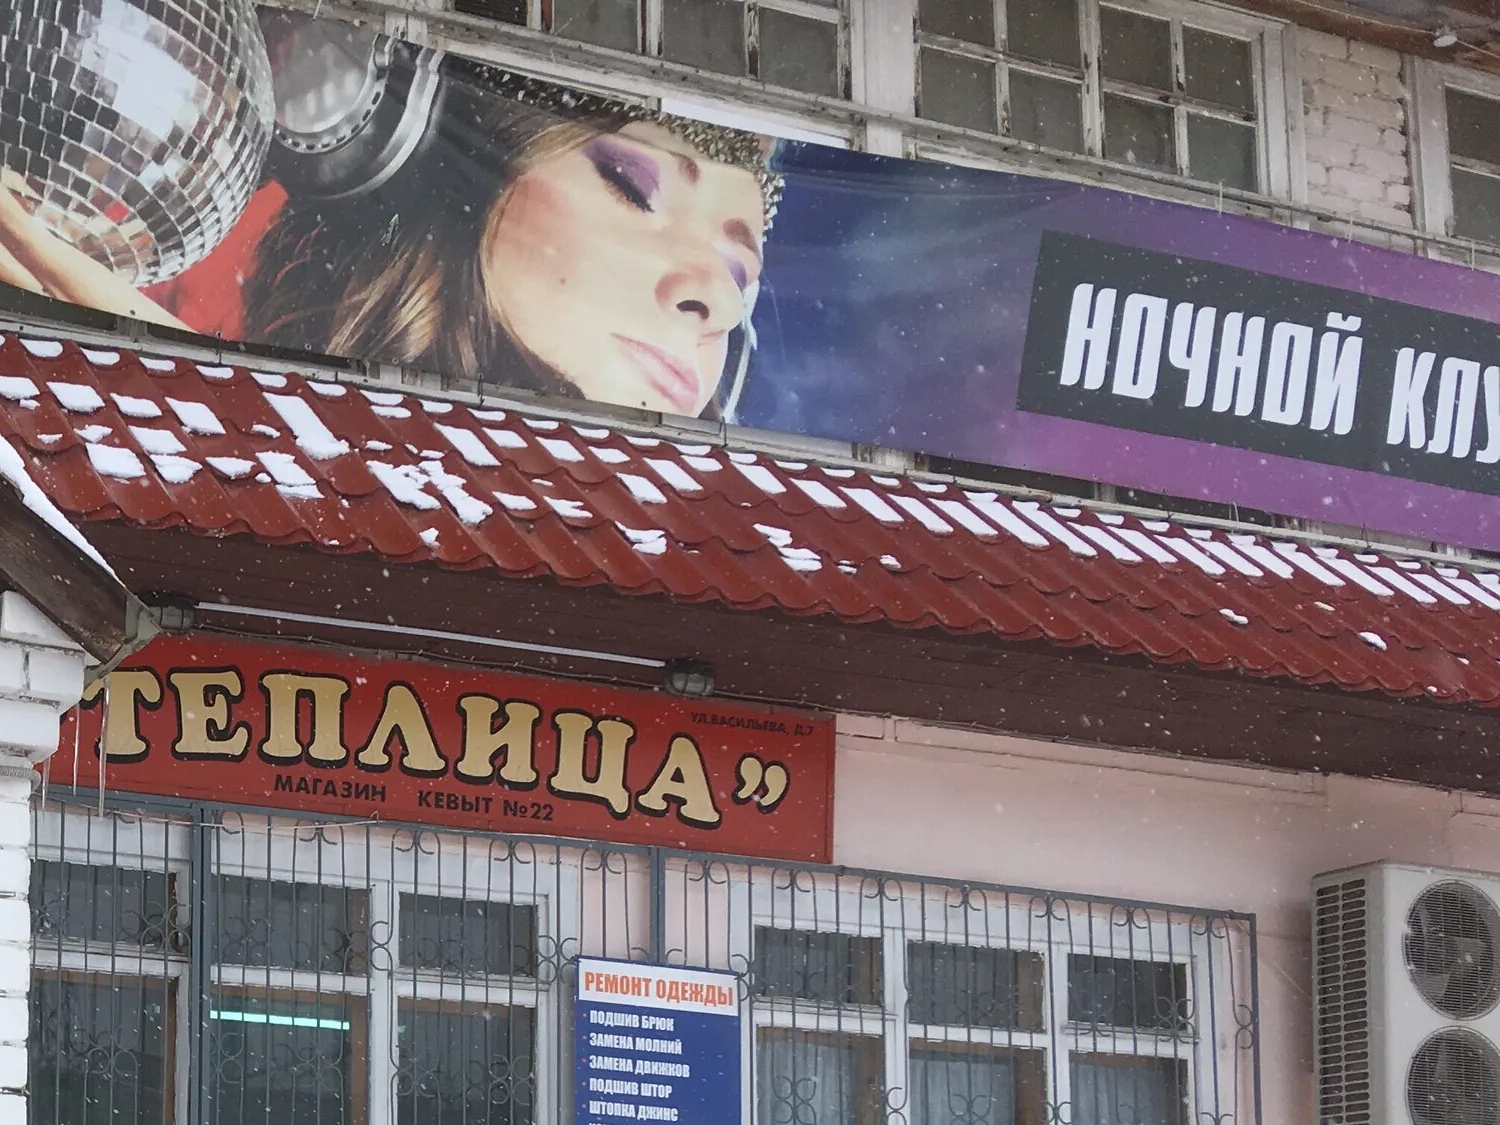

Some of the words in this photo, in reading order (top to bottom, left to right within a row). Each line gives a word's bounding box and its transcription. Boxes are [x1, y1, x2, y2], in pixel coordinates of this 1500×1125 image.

[1060, 282, 1364, 436] НОЧНОЙ
[274, 774, 387, 803] МАГАЗИН
[417, 790, 493, 816] КЕВЫТ
[502, 799, 555, 822] №22
[584, 971, 653, 999] РЕМОНТ
[656, 978, 734, 1008] ОДЕЖДЫ
[589, 1010, 640, 1029] ПОДШИВ
[641, 1015, 674, 1032] БРЮК
[589, 1032, 634, 1050] ЗАМЕНА
[635, 1036, 682, 1055] МОЛНИЙ
[589, 1055, 633, 1073] ЗАМЕНА
[634, 1058, 691, 1078] ДВИЖКОВ
[589, 1077, 639, 1096] ПОДШИВ
[640, 1081, 673, 1098] ШТОР
[589, 1100, 636, 1119] ШТОПКА
[637, 1104, 679, 1122] ДЖИНС
